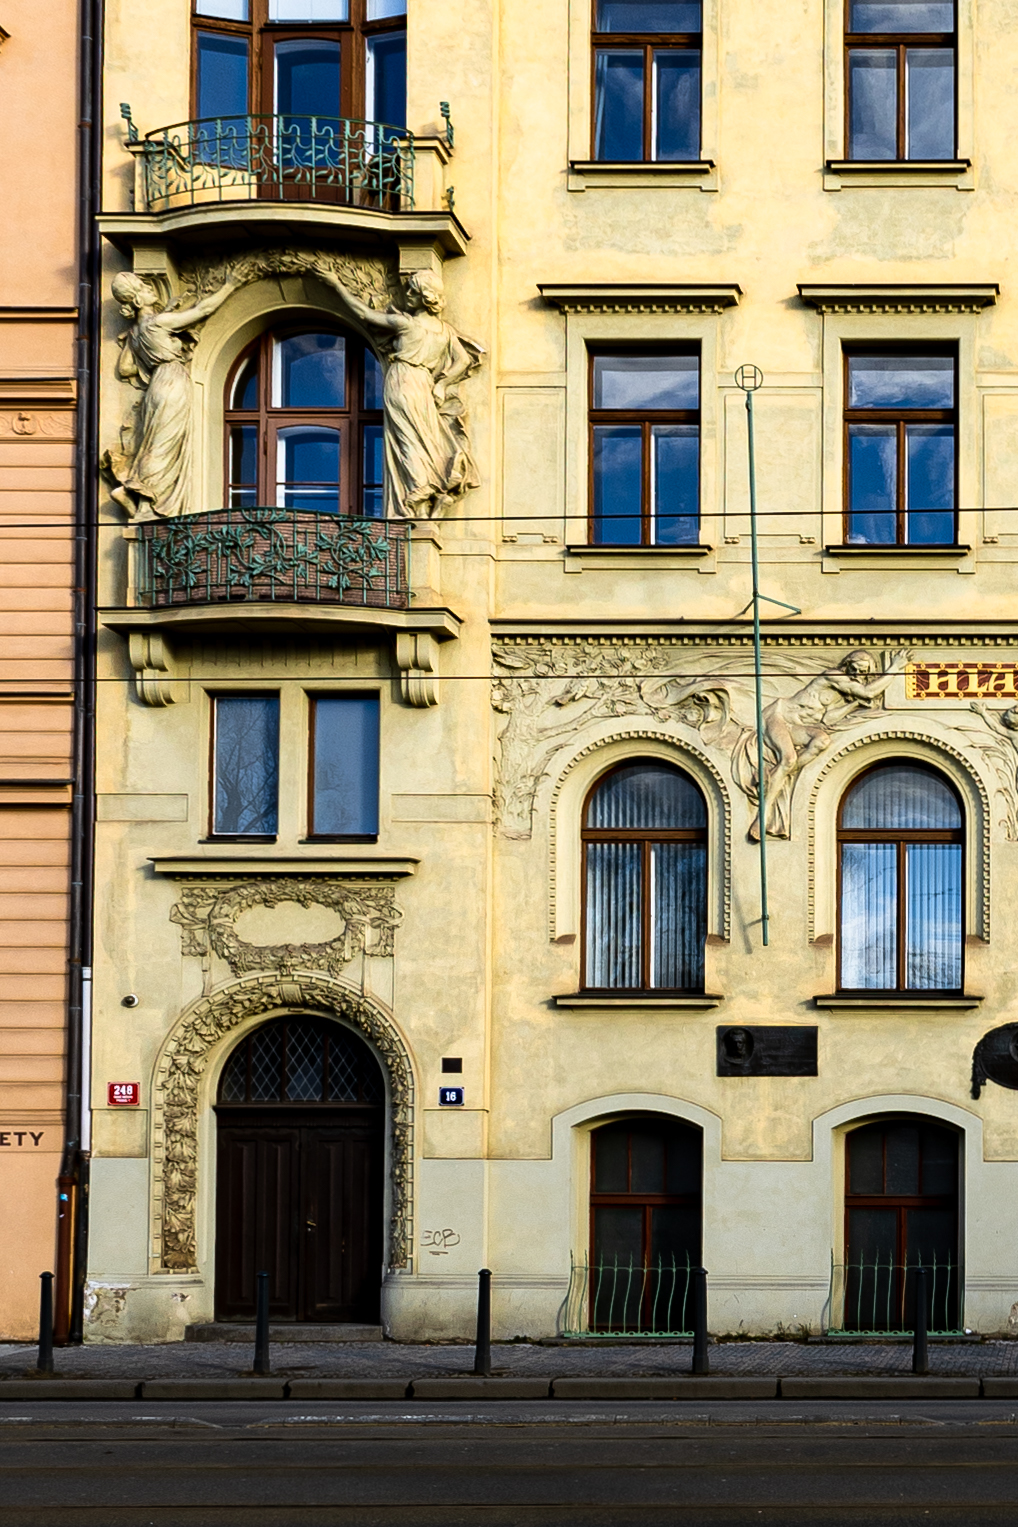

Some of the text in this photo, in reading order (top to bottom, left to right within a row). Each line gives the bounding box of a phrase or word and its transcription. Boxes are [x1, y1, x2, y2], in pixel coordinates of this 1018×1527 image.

[113, 1084, 134, 1096] 248
[445, 1090, 457, 1102] 16
[0, 1131, 45, 1147] ETY
